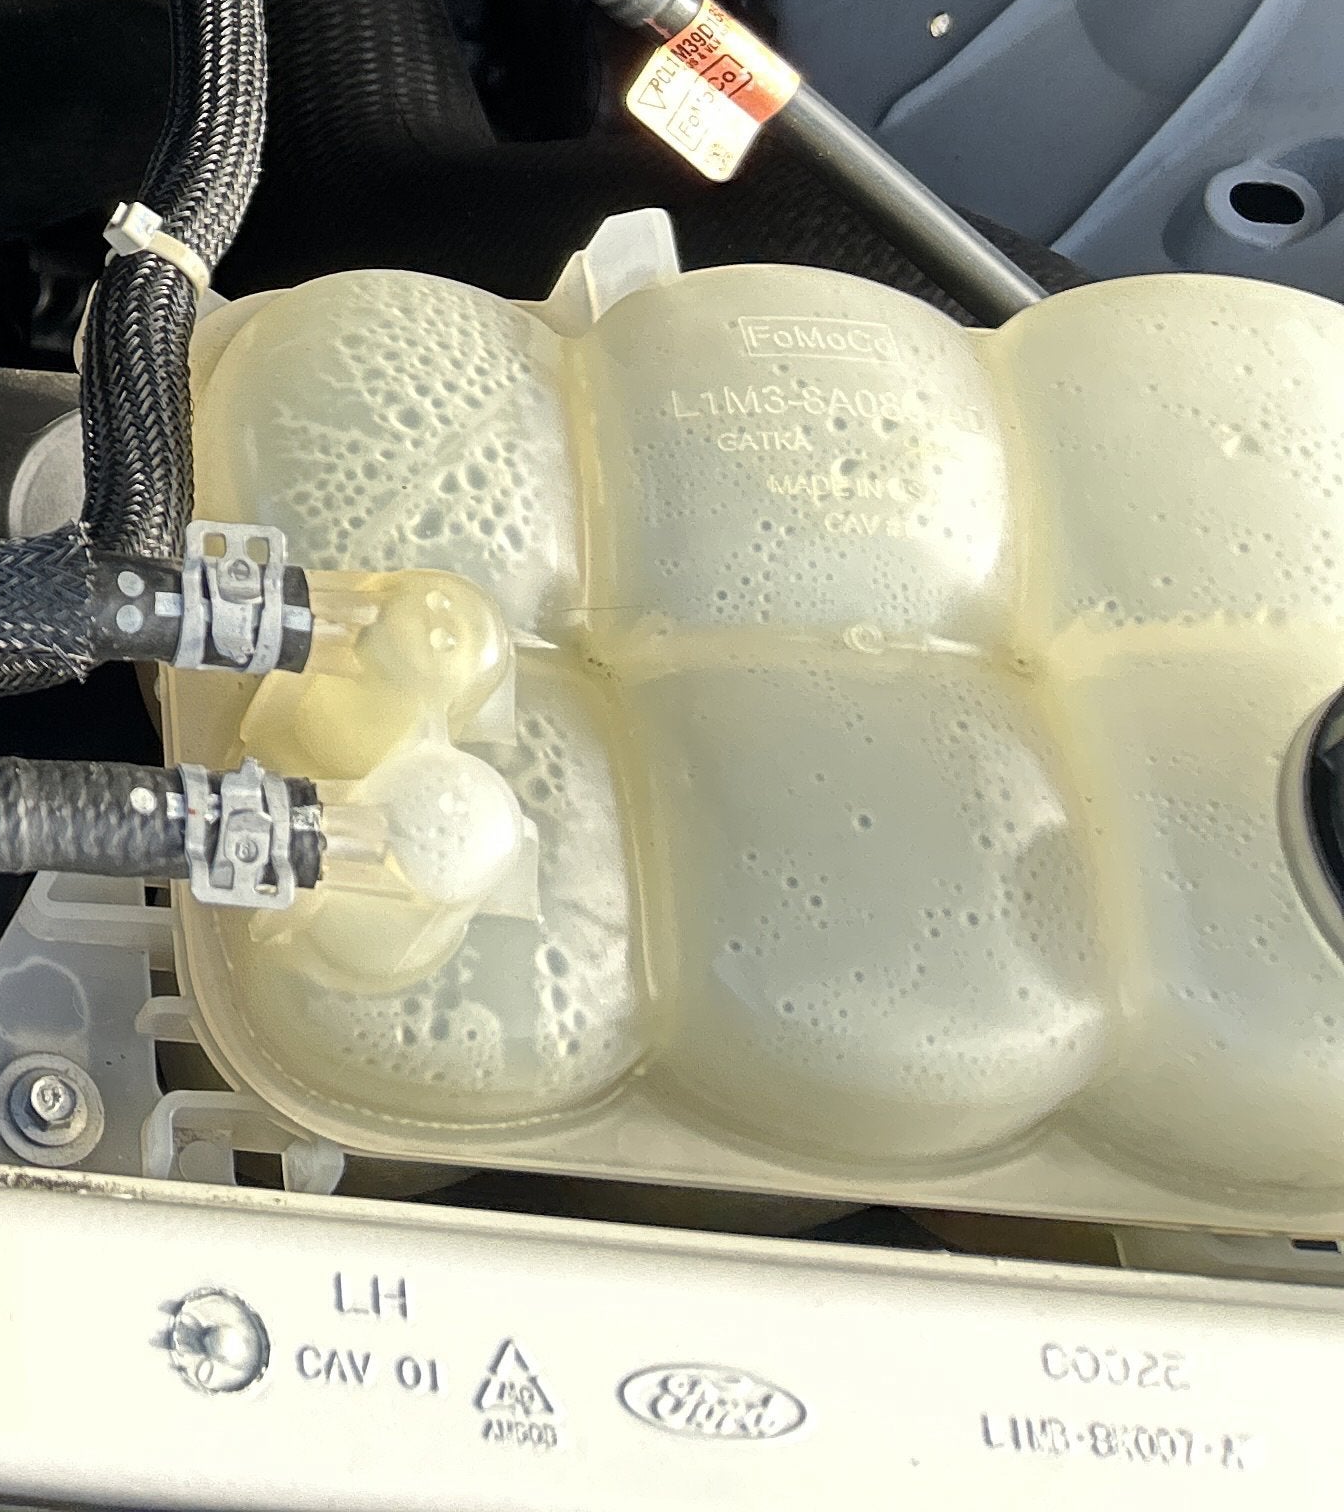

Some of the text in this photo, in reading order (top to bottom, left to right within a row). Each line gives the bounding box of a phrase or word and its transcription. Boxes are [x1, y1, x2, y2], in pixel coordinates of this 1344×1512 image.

[747, 324, 895, 356] FoMoCo
[333, 1270, 409, 1321] LH
[295, 1343, 372, 1385] CAV
